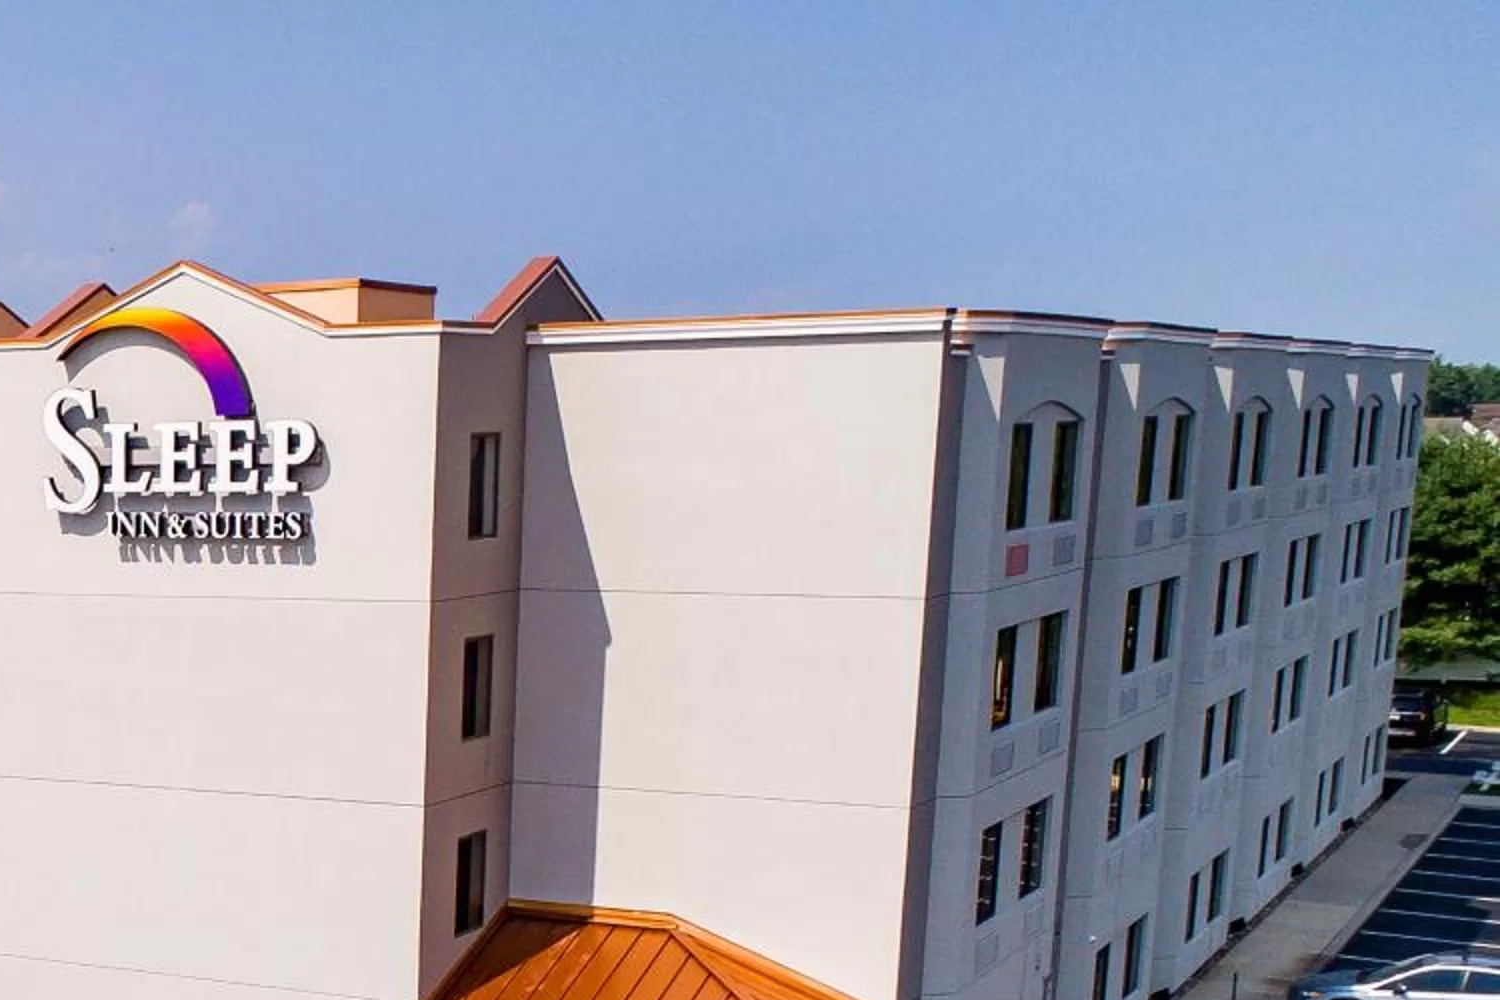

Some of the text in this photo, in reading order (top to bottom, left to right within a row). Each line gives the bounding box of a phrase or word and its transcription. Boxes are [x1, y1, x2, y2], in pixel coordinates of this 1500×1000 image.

[42, 386, 318, 515] SLEEP
[105, 511, 301, 540] INN & SUITES
